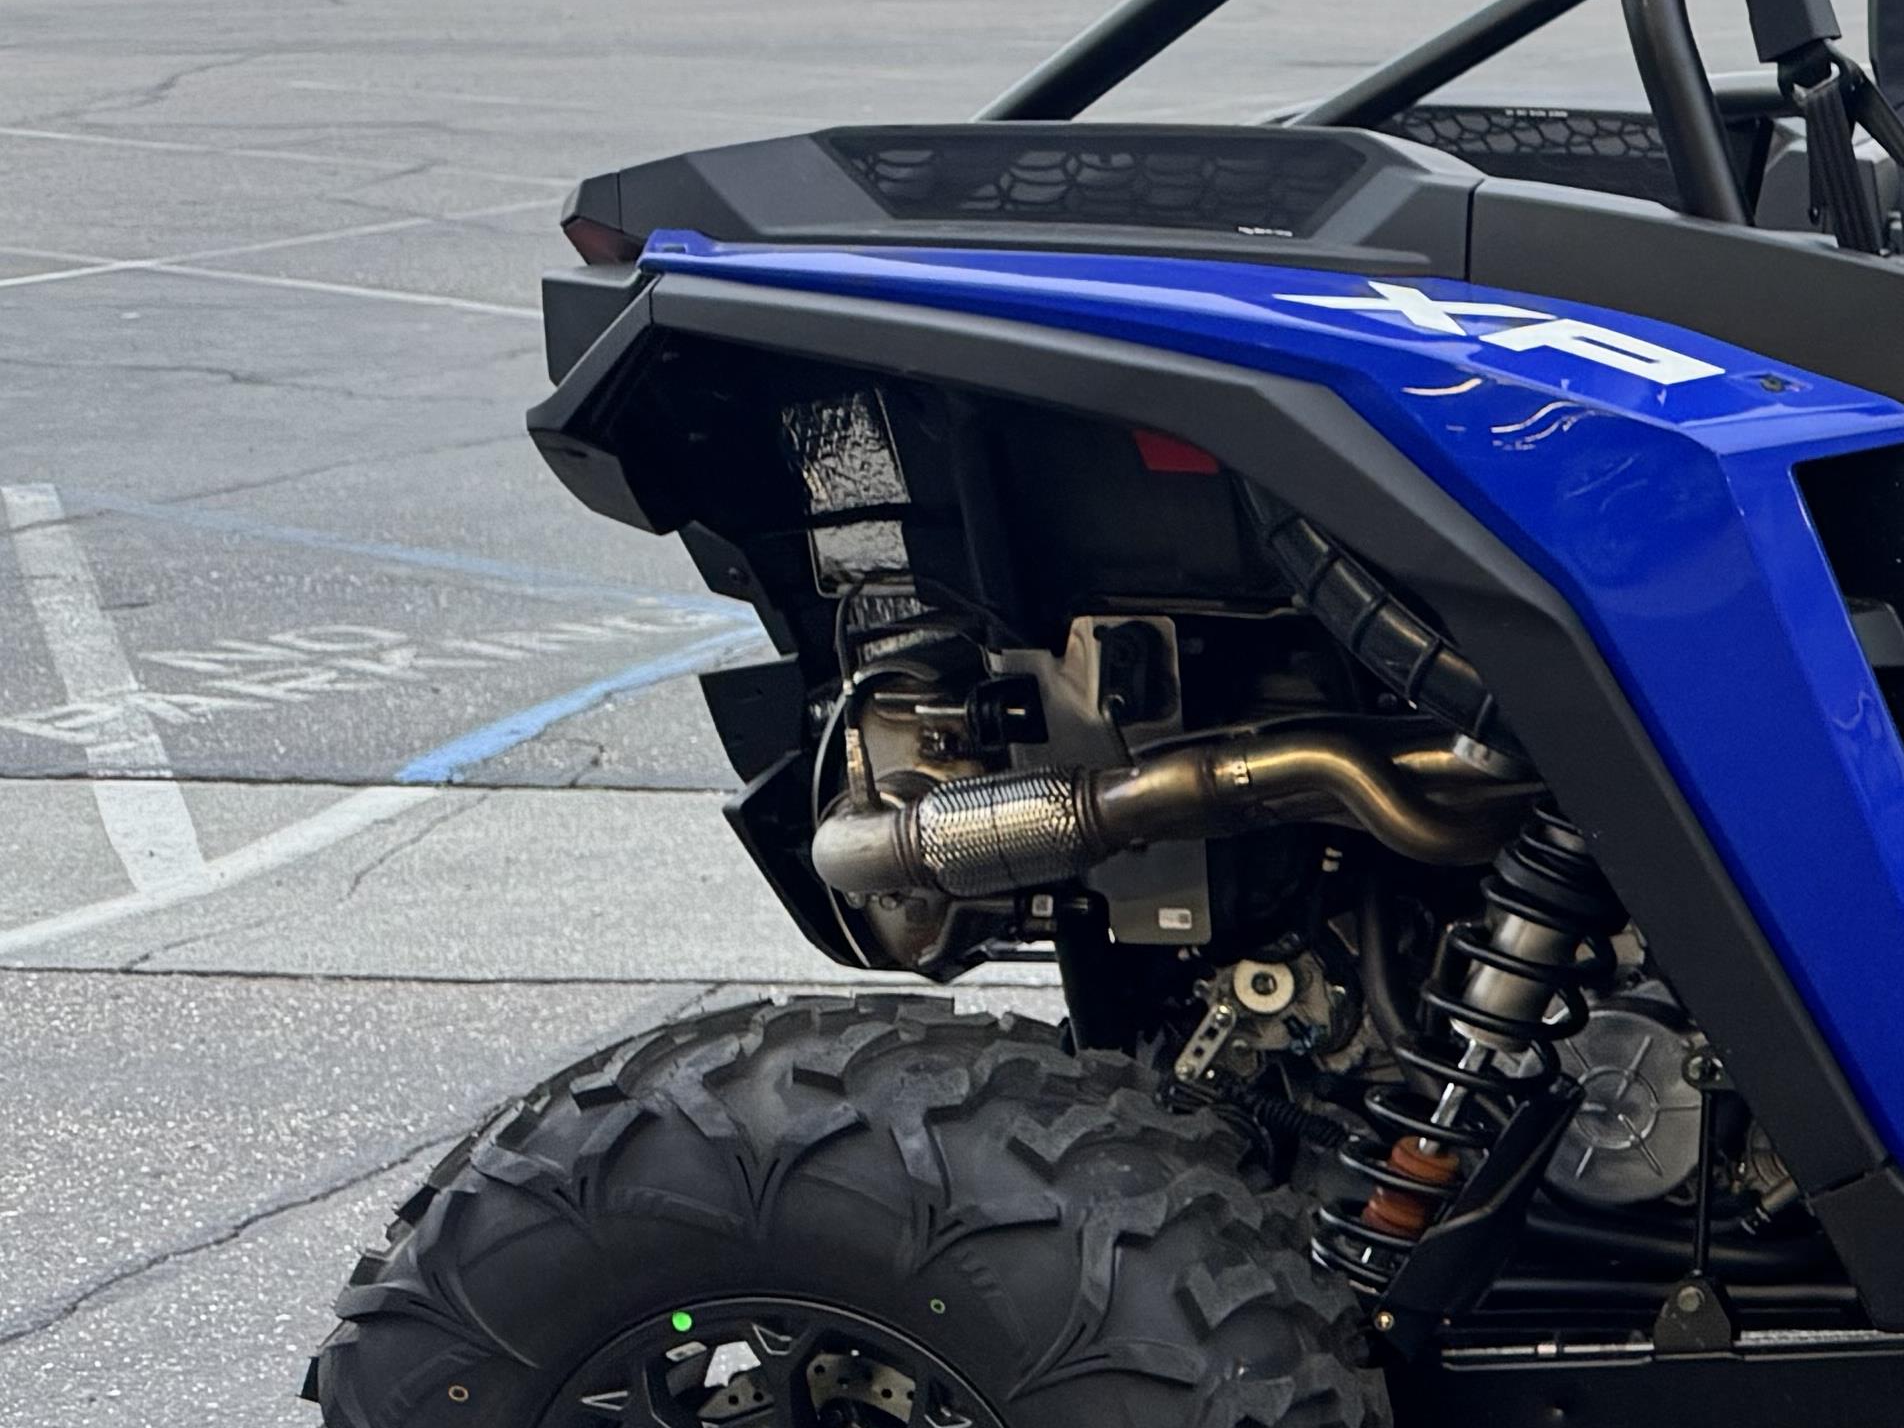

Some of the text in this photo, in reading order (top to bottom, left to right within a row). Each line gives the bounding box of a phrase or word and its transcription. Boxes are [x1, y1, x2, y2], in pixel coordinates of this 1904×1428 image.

[1273, 280, 1726, 385] XP
[0, 612, 724, 743] PARKING
[137, 624, 408, 674] NO
